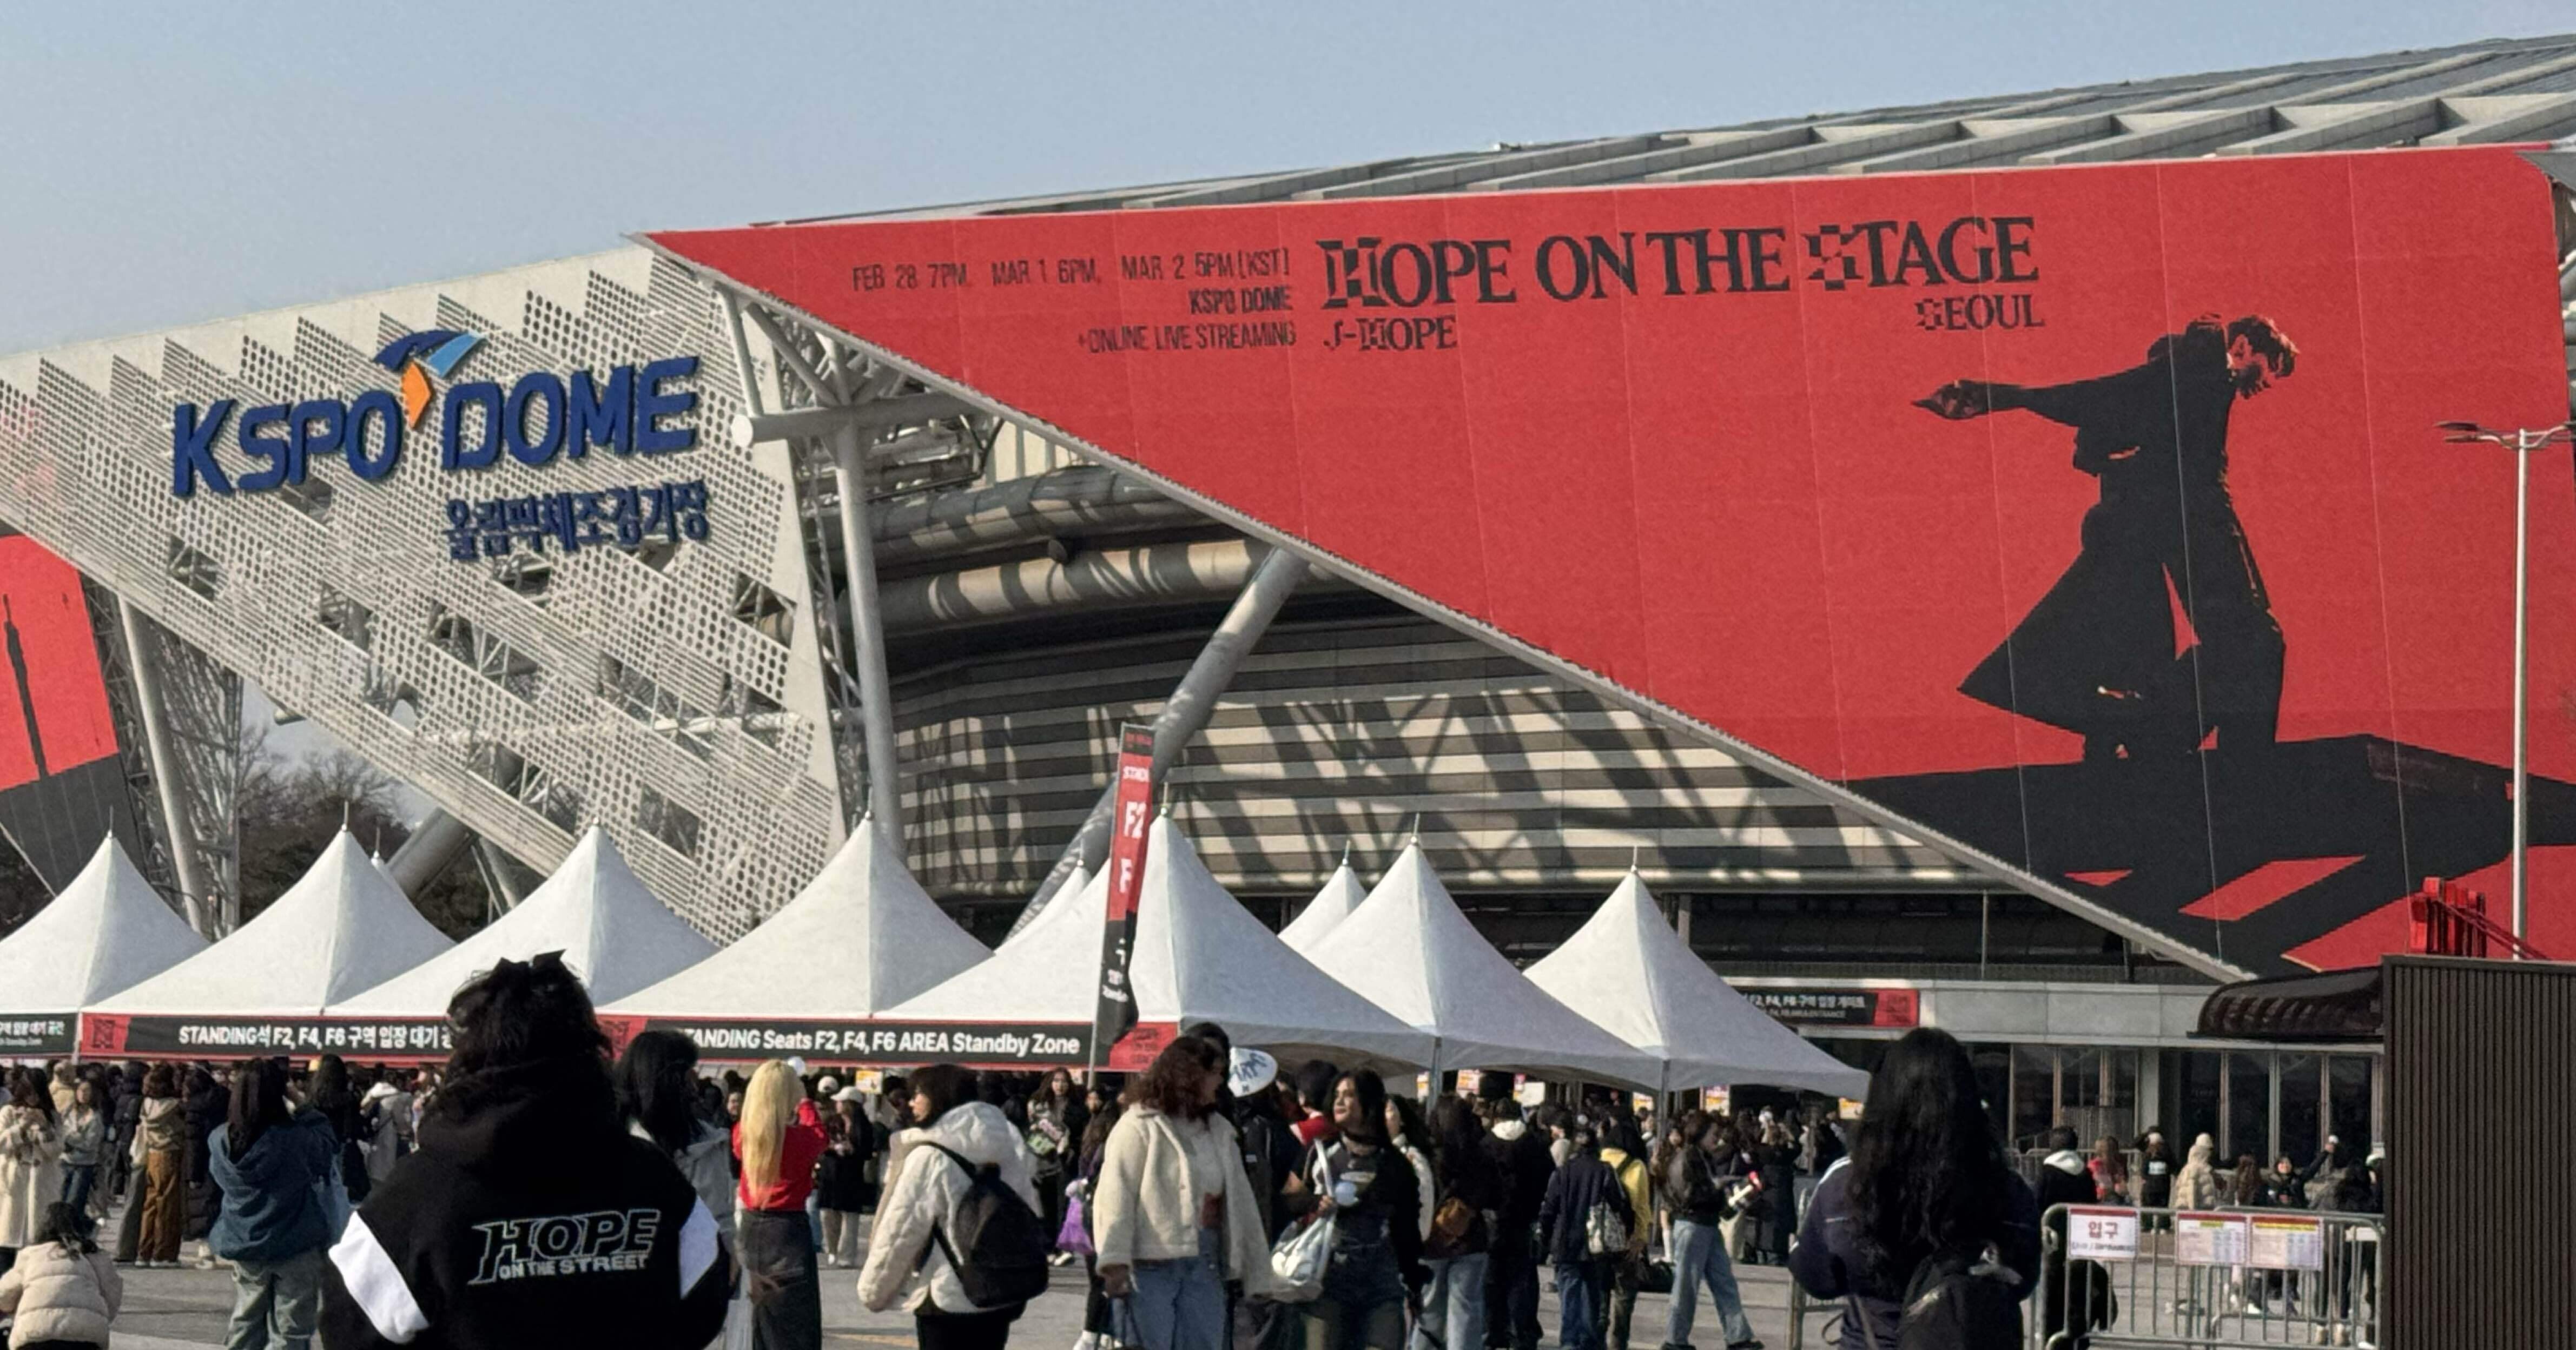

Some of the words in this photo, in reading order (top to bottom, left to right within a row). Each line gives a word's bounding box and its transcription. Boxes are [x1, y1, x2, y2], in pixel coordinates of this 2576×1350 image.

[853, 264, 885, 291] FEB
[895, 264, 918, 289] 28
[991, 260, 1028, 286] MAR
[1038, 259, 1048, 283] 1
[1121, 255, 1163, 280] MAR
[1173, 255, 1185, 280] 2
[1316, 237, 1517, 309] HOPE
[1535, 232, 1637, 302] ON
[1646, 227, 1790, 295] THE
[1800, 216, 2039, 292] STAGE
[1188, 288, 1236, 314] KSPO
[1241, 286, 1293, 314] DOME
[1915, 294, 2045, 330] SEOUL
[1154, 325, 1192, 350] LIVE
[1194, 321, 1297, 350] STREAMING
[1323, 315, 1457, 352] J-HOPE
[173, 389, 402, 497] KSPO
[441, 355, 699, 471] DOME
[446, 479, 709, 560] 올림픽체조경기장
[273, 1027, 295, 1050] F2,
[299, 1027, 323, 1050] F4,
[325, 1027, 346, 1046] F6
[348, 1025, 377, 1049] 구역
[380, 1025, 407, 1049] 입장
[409, 1025, 438, 1049] 대기
[763, 1031, 811, 1050] Seats
[815, 1031, 840, 1054] F2,
[843, 1033, 870, 1054] F4,
[873, 1033, 896, 1051] F6
[899, 1033, 949, 1053] AREA
[953, 1034, 1029, 1057] Standby
[1032, 1034, 1080, 1054] Zone
[467, 1208, 661, 1285] HOPE
[2088, 1221, 2118, 1239] 입구
[499, 1263, 524, 1280] ON
[526, 1261, 556, 1276] THE
[559, 1253, 649, 1274] STREET
